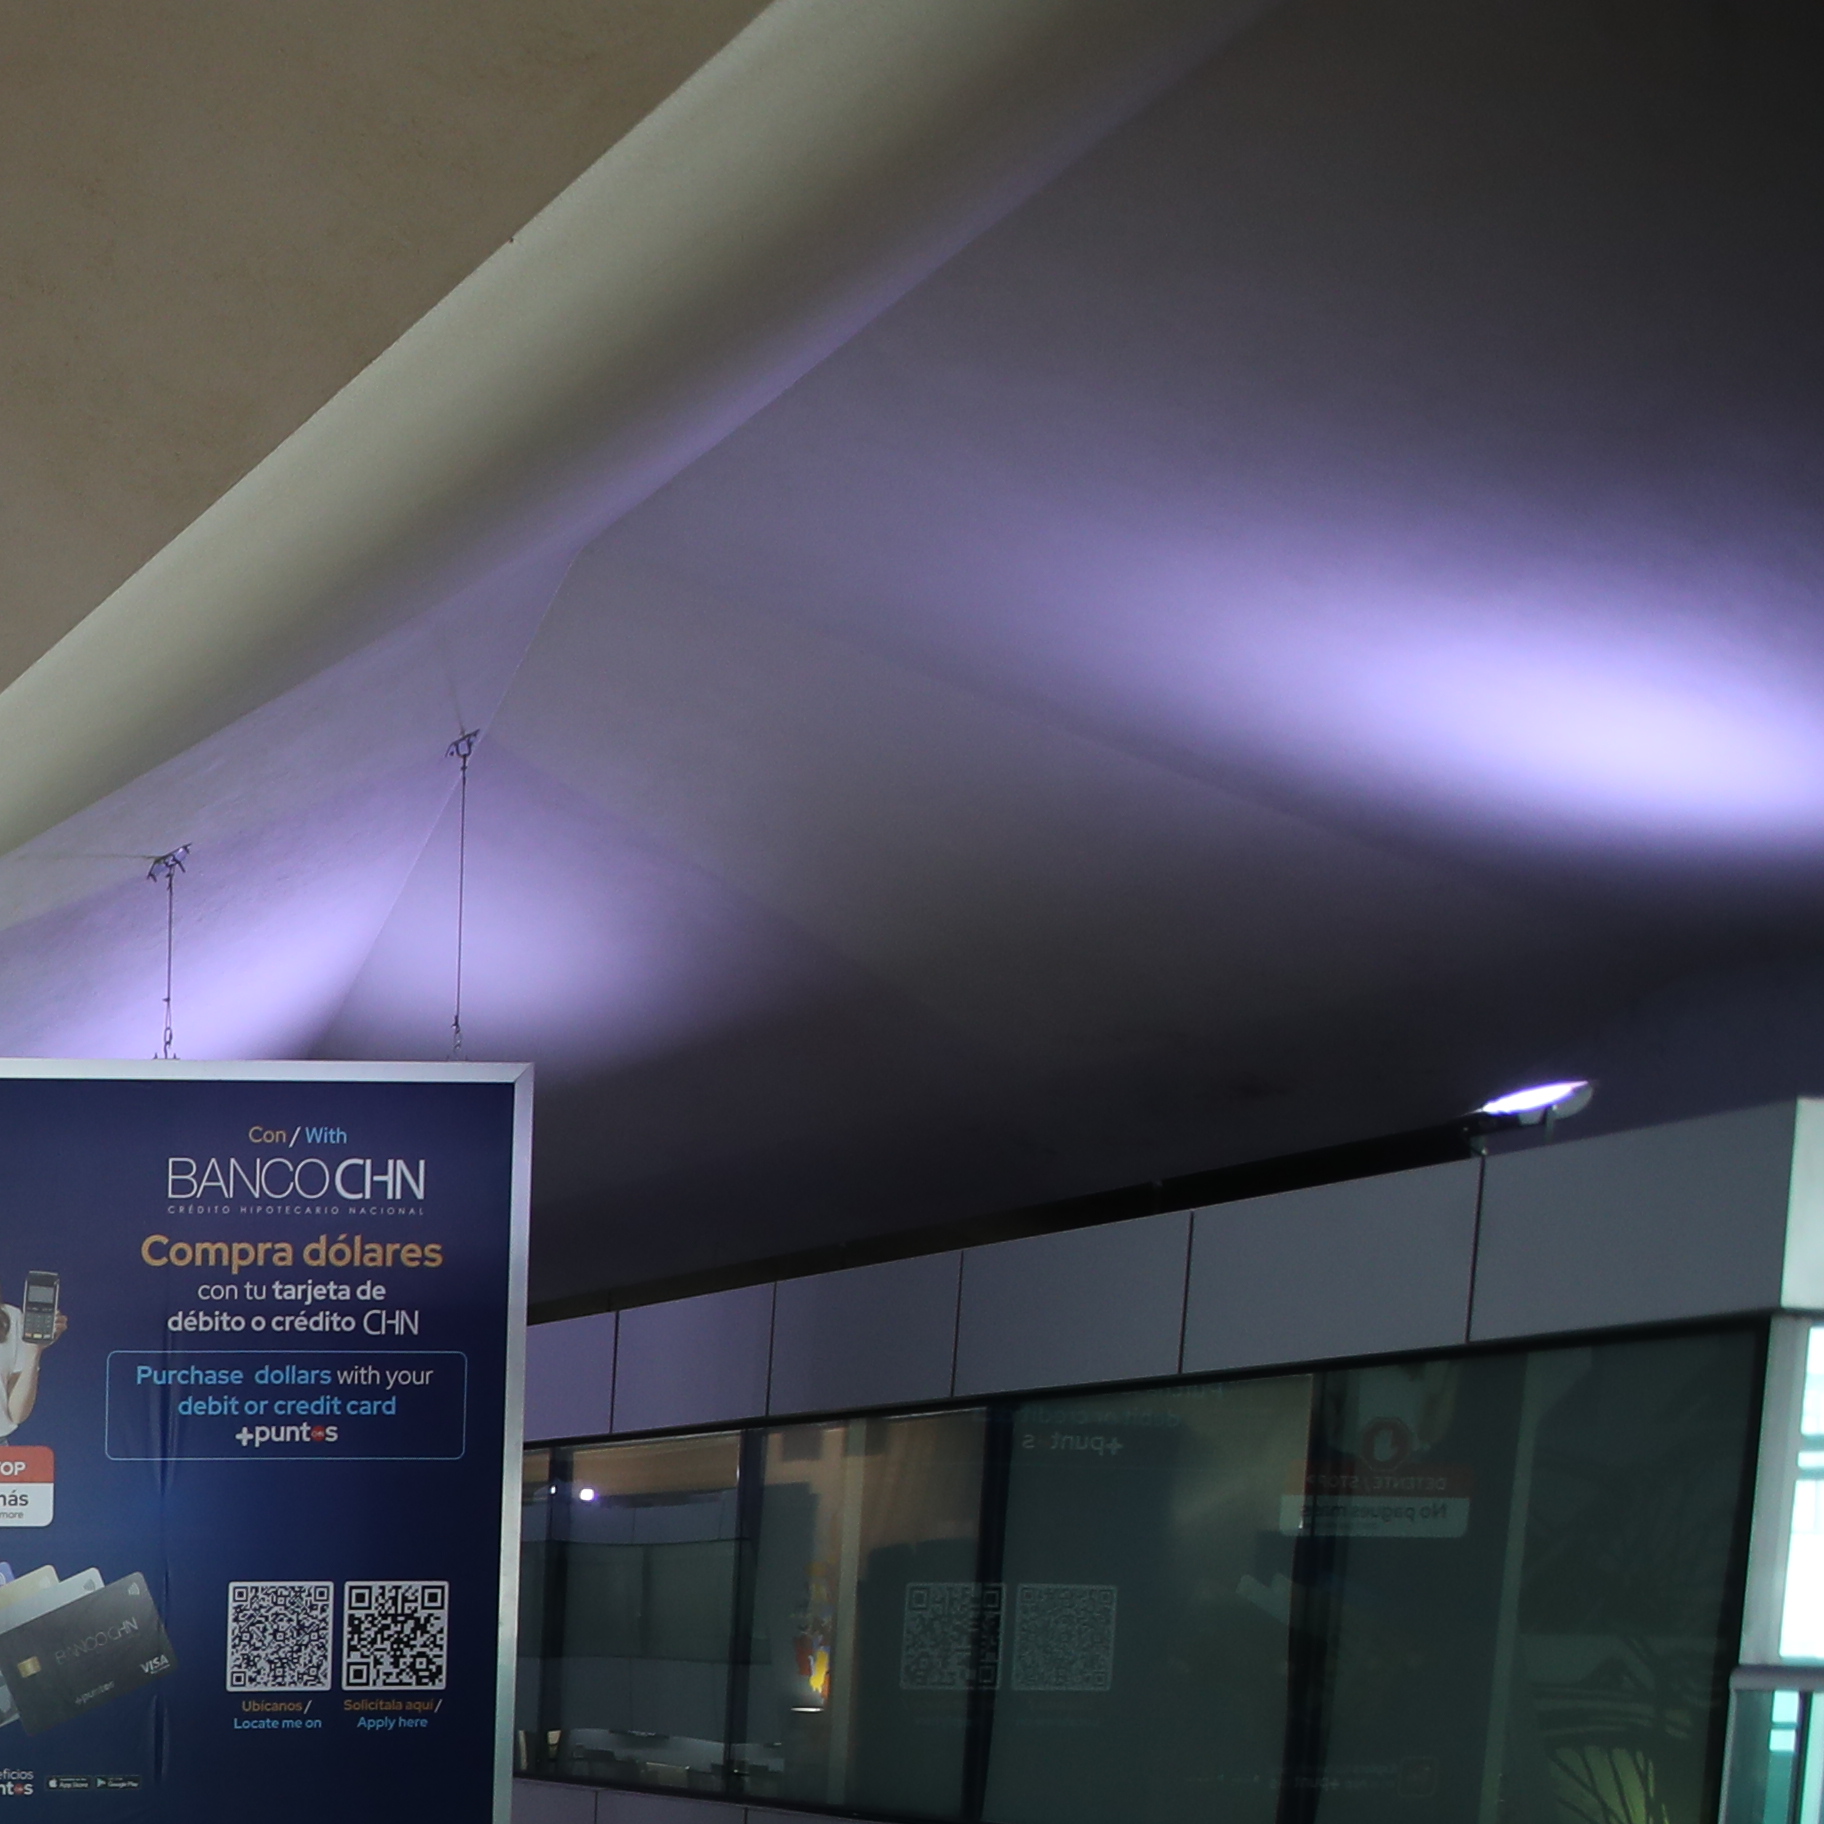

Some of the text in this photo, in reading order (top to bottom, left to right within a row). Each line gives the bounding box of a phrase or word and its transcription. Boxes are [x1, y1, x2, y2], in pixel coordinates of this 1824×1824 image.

[248, 1125, 287, 1144] Con
[305, 1127, 348, 1145] With
[167, 1203, 425, 1217] CRÉDITO HIPOTECARIO NACIONAL
[141, 1233, 444, 1275] Compra dólares
[197, 1280, 387, 1305] con tu tarjeta de
[167, 1309, 420, 1336] débito o crédito CHN
[135, 1364, 435, 1391] Purchase dollars with your
[177, 1395, 398, 1416] debit or credit card
[0, 1511, 25, 1520] more
[139, 1654, 170, 1674] VISA
[233, 1717, 323, 1730] Locate me on
[356, 1716, 429, 1731] Apply here
